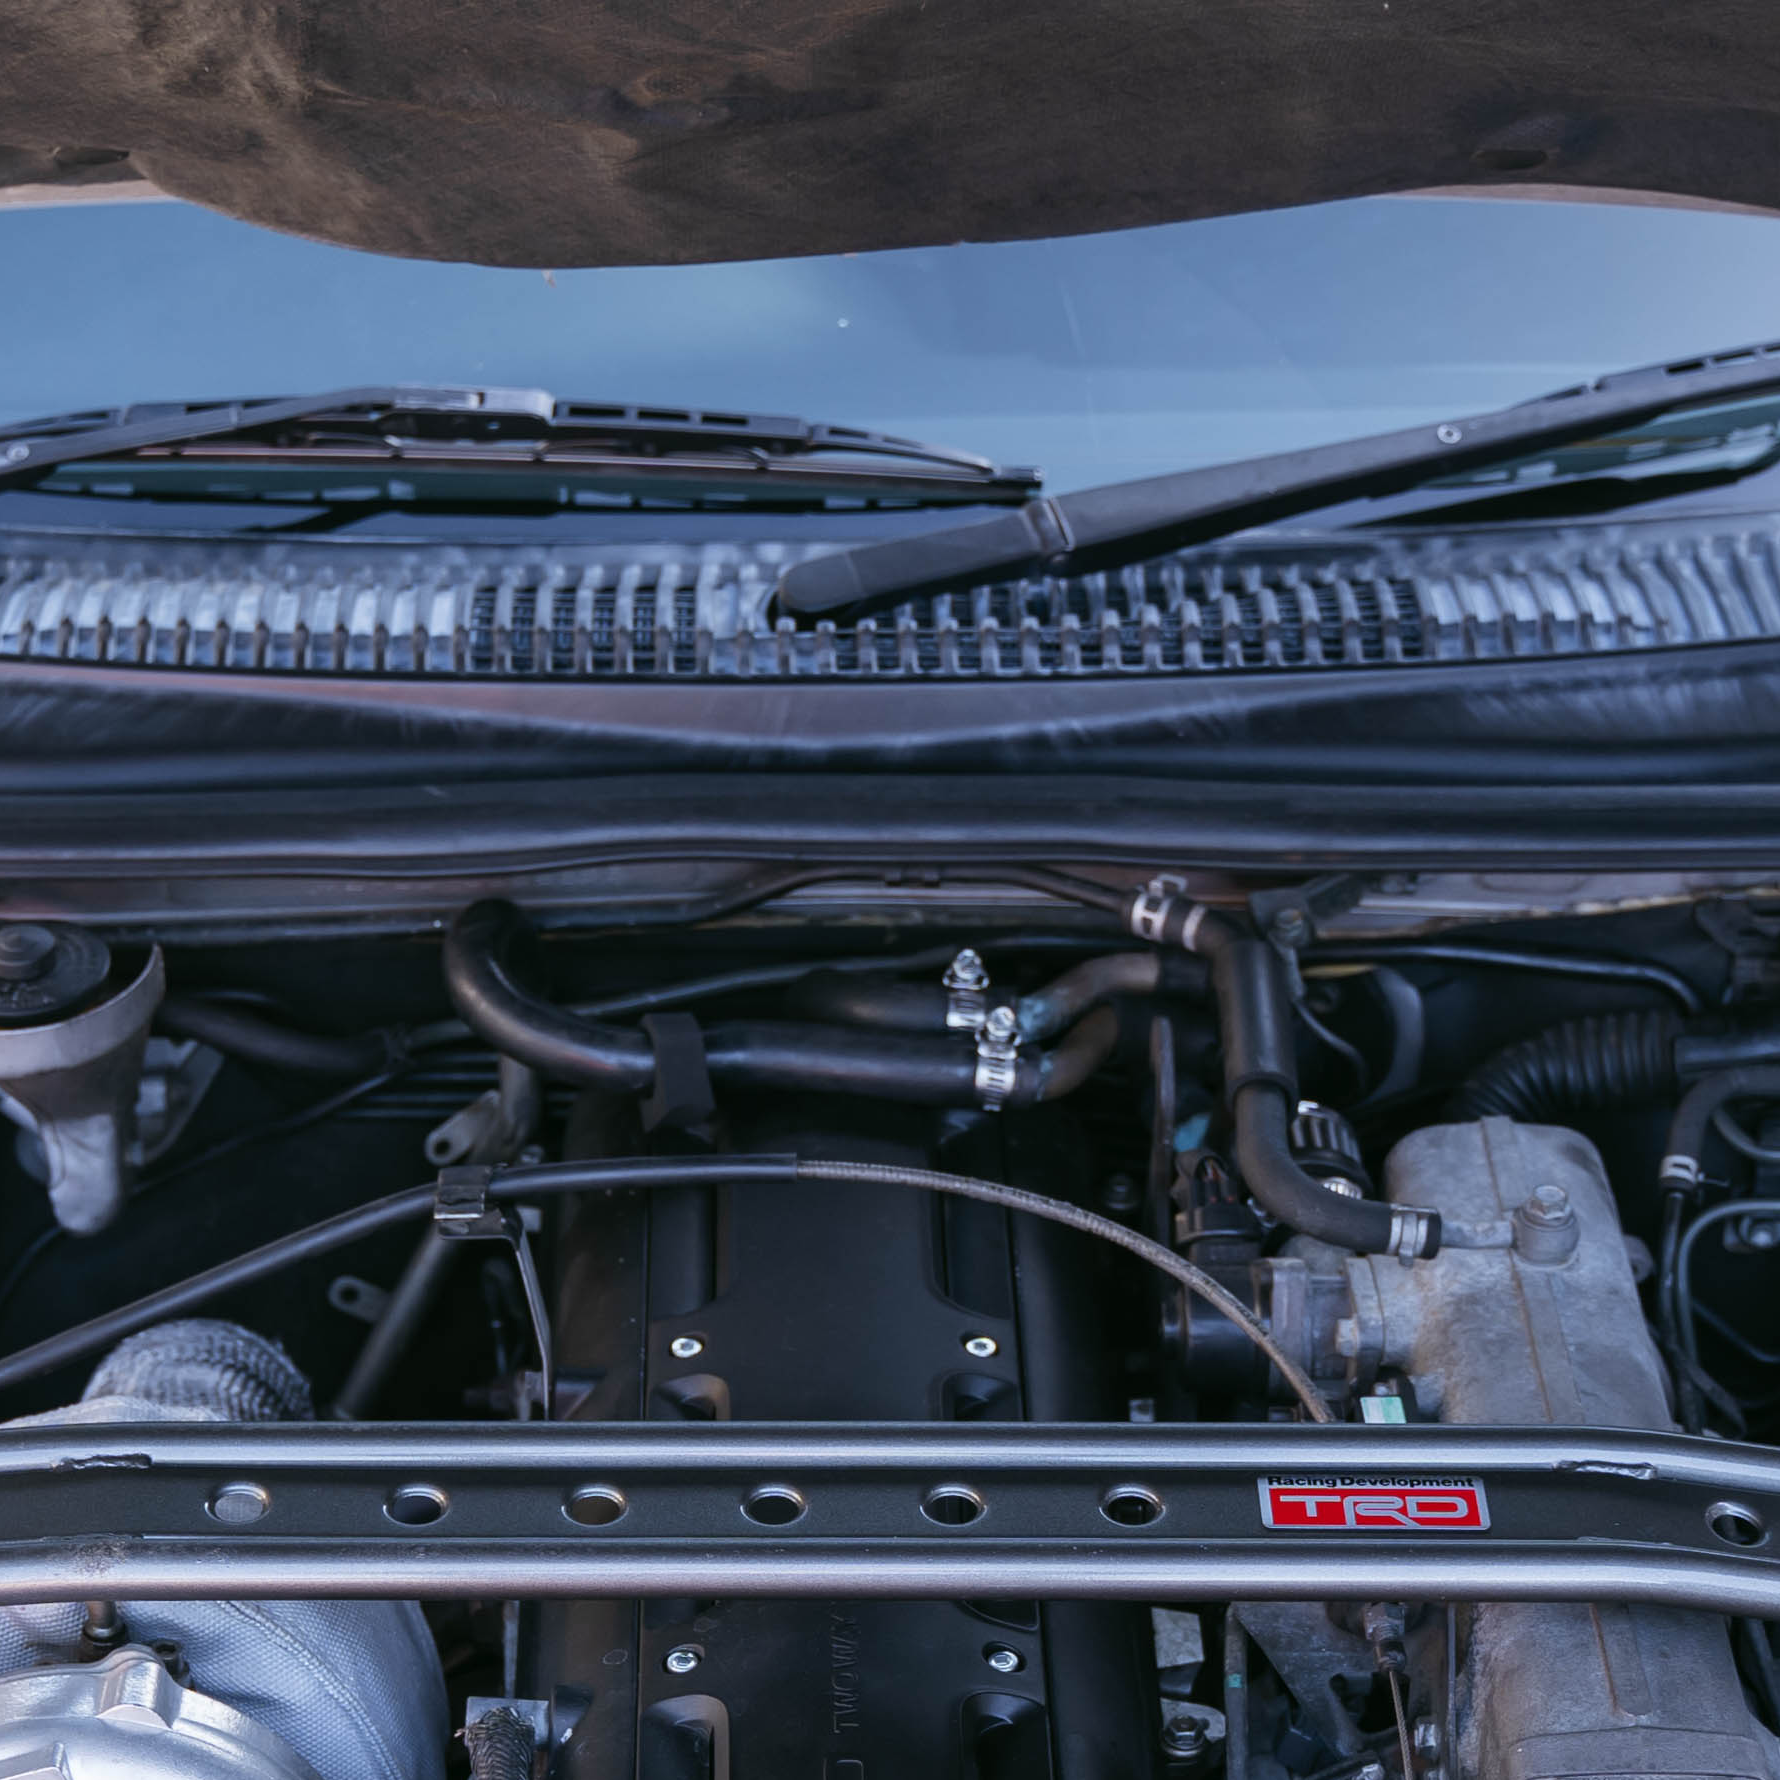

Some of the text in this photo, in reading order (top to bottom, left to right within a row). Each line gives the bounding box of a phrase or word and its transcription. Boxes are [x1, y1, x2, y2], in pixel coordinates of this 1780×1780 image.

[1268, 1476, 1475, 1489] Racing Development
[1279, 1495, 1469, 1527] TRD
